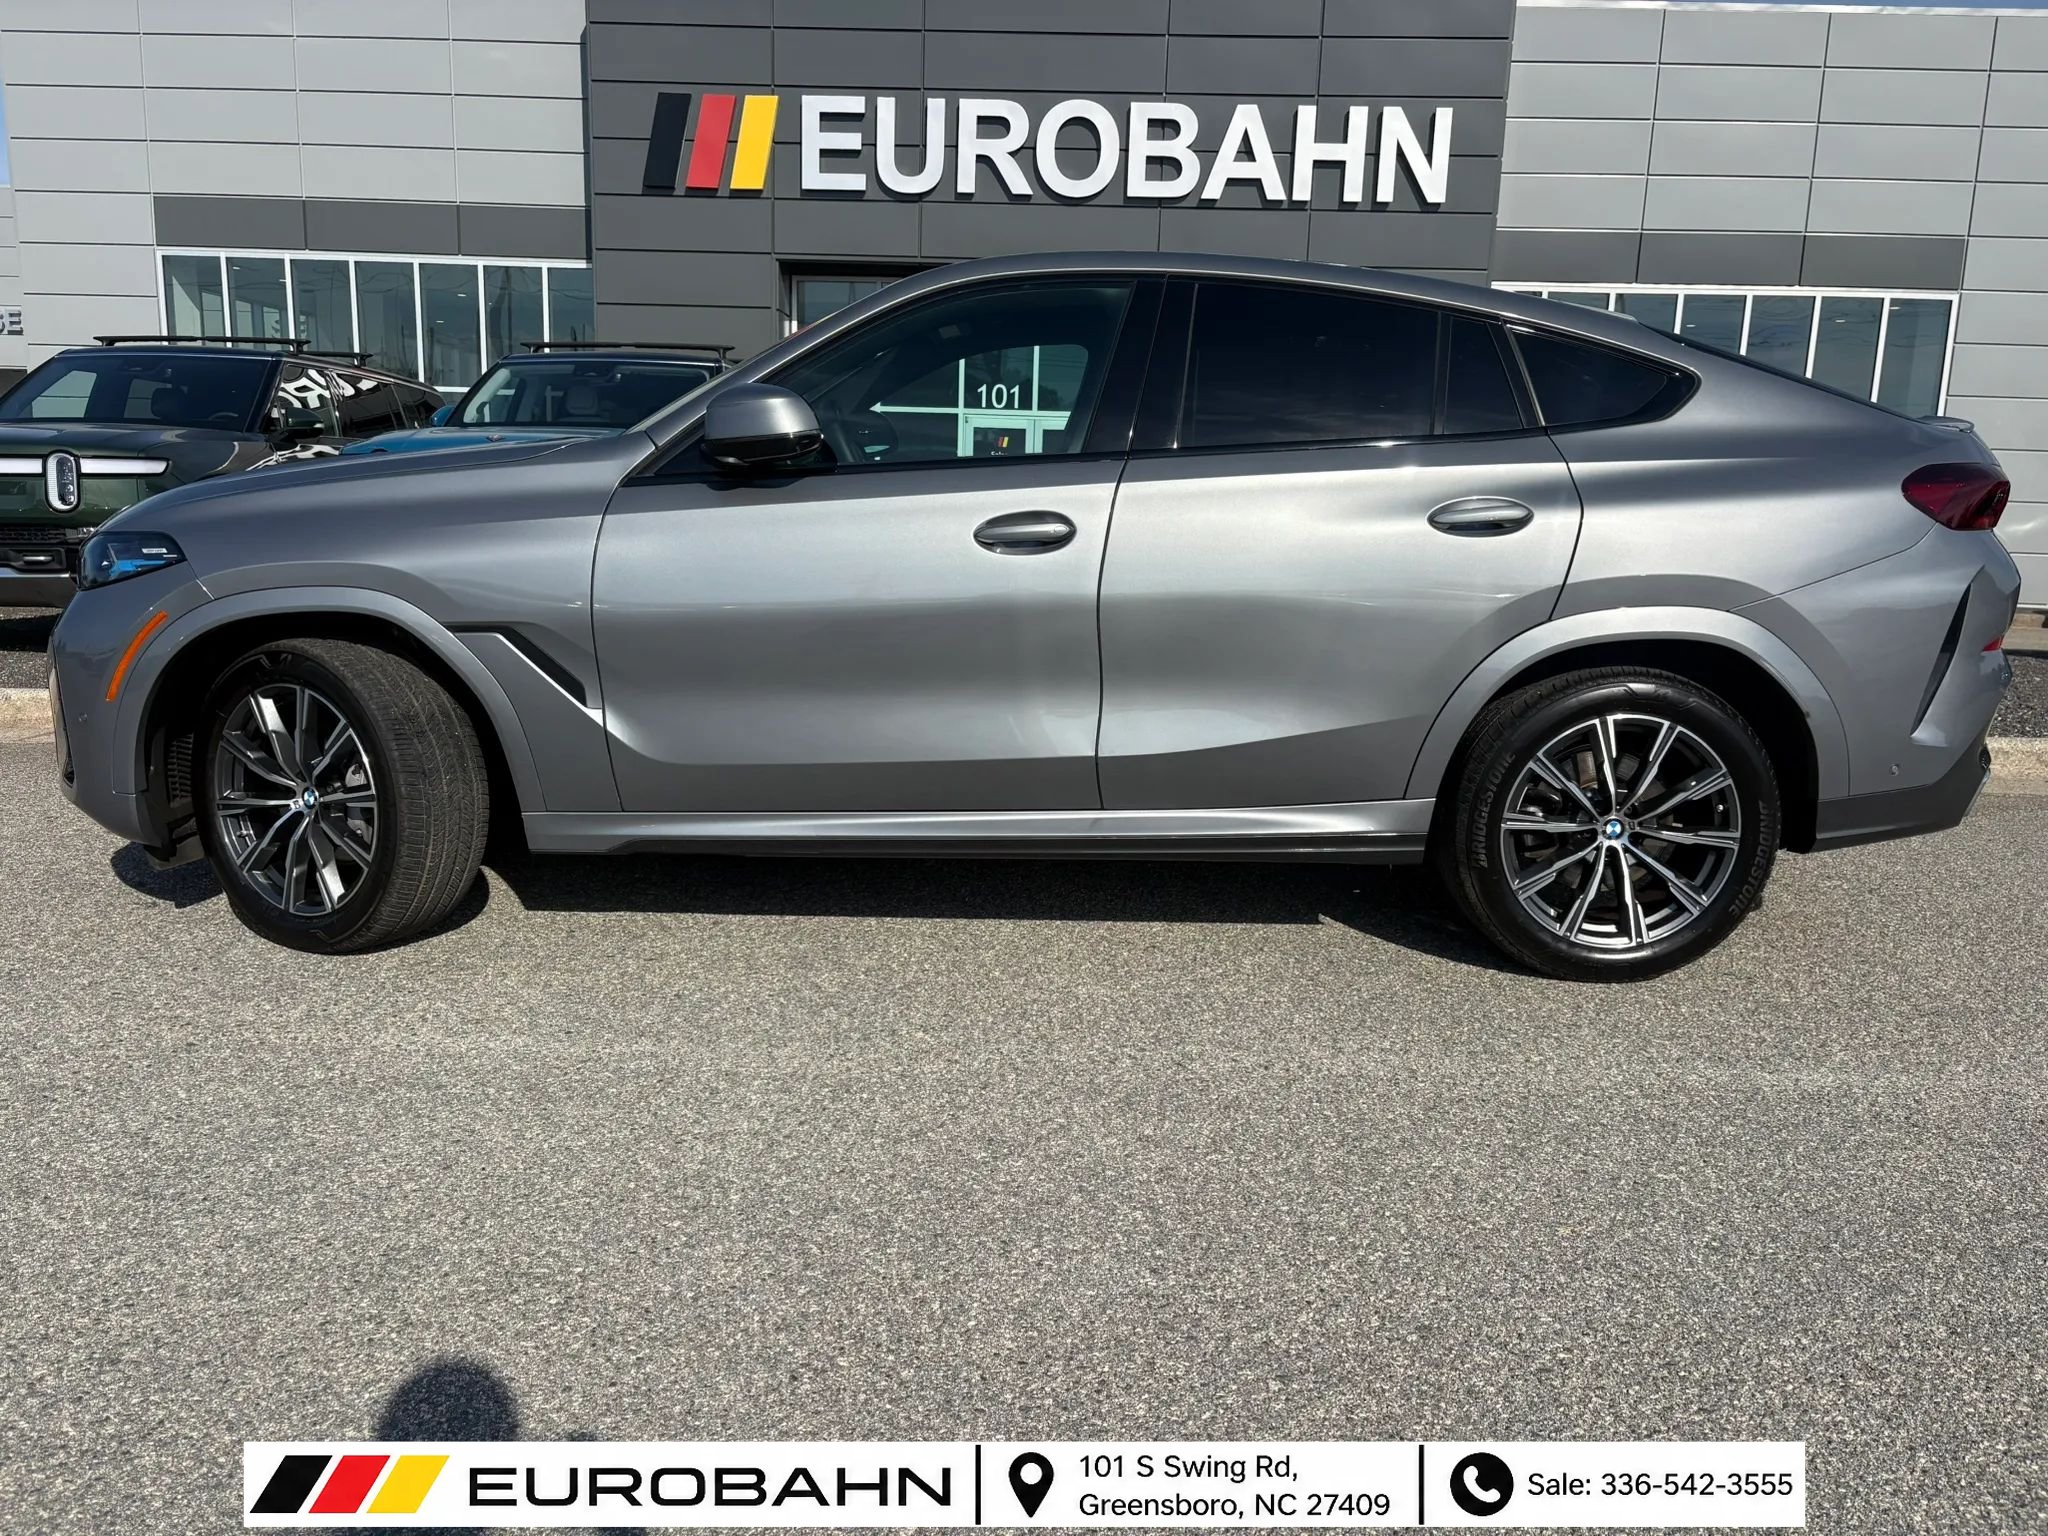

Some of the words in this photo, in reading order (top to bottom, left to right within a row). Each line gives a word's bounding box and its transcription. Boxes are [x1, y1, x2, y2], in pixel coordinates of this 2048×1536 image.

[801, 94, 1454, 205] EUROBAHN
[977, 383, 1020, 409] 101
[1471, 751, 1517, 868] BRIDGESTONE
[1728, 800, 1775, 917] BRIDGESTONE
